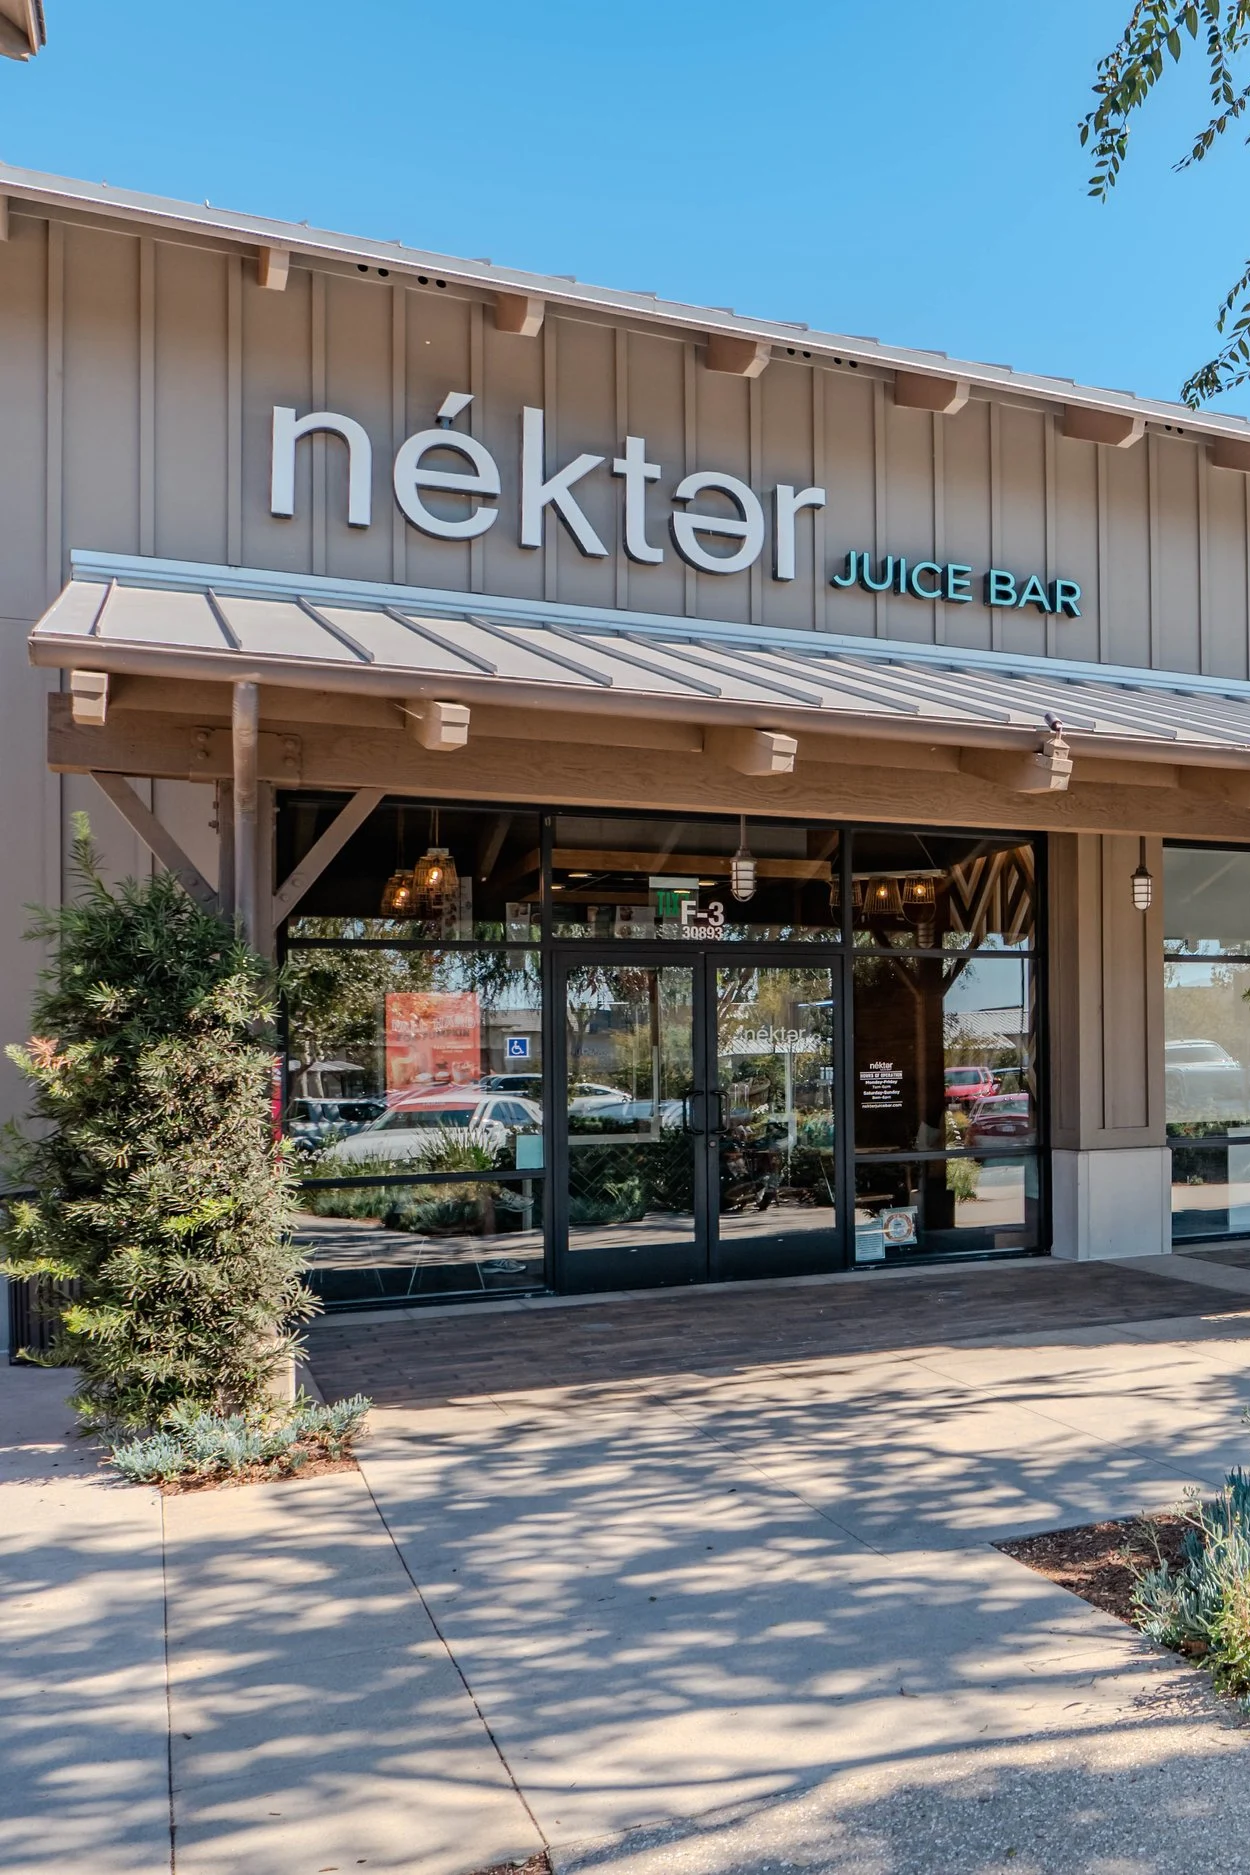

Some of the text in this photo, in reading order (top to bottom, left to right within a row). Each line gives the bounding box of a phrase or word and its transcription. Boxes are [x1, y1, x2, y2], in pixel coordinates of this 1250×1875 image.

[832, 550, 1082, 618] JUICE BAR
[681, 900, 725, 927] F-3
[682, 926, 723, 940] 30893
